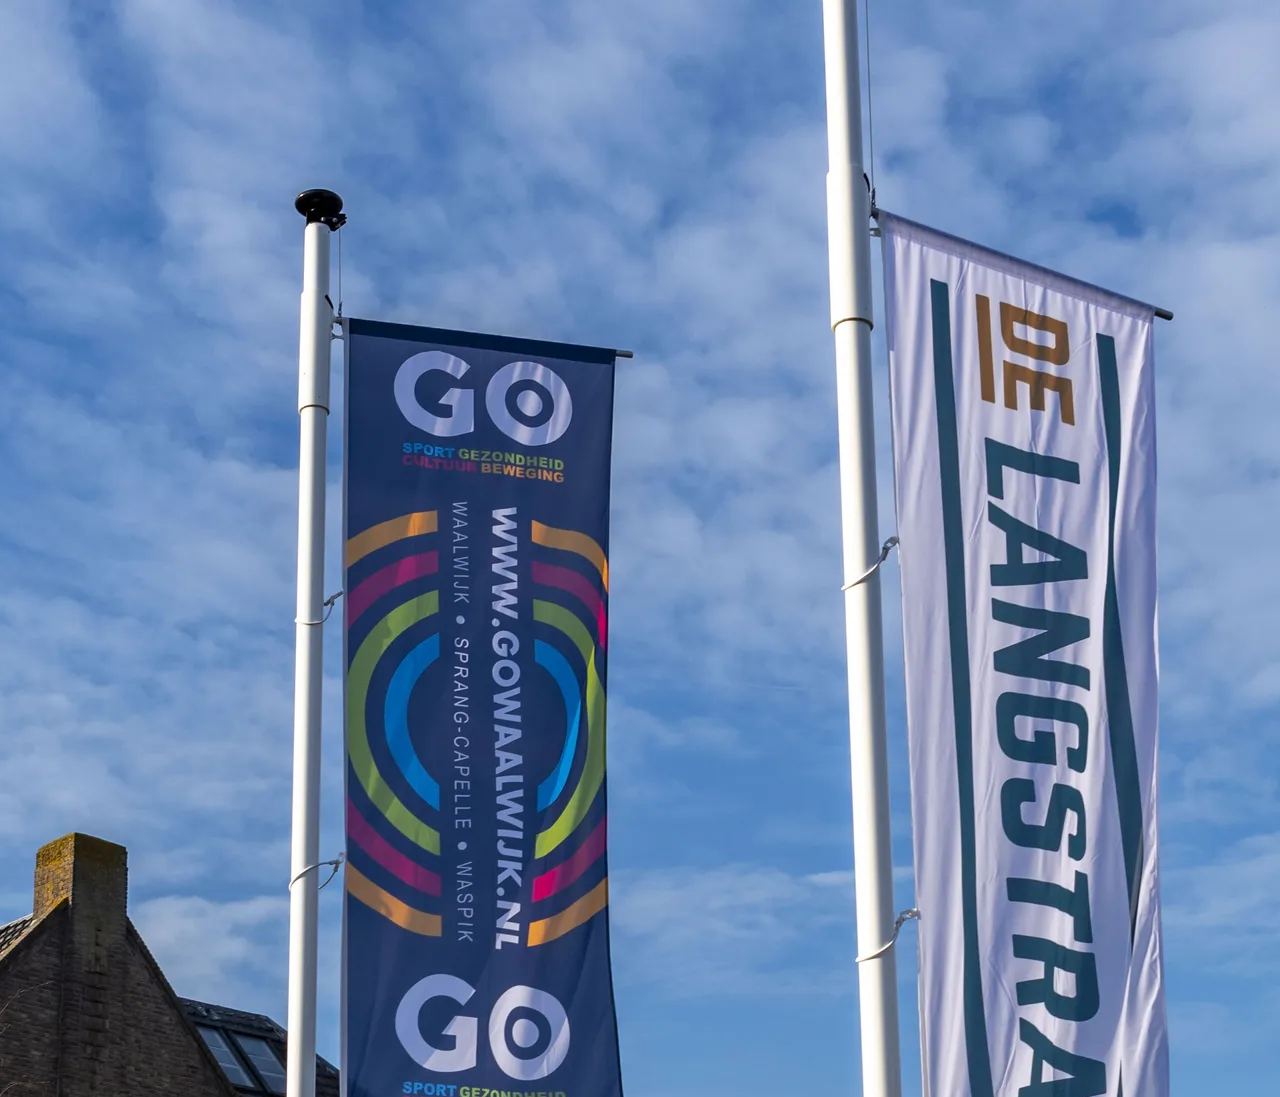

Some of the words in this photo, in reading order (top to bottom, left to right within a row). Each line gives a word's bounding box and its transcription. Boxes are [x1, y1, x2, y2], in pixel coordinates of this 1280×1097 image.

[393, 350, 573, 446] GO
[999, 301, 1075, 426] DE
[402, 455, 477, 474] CULTUUR
[481, 463, 565, 483] BEWEGING
[403, 442, 456, 458] SPORT
[458, 448, 565, 471] GEZONDHEID
[452, 501, 470, 605] WAALWIJK
[454, 637, 472, 829] SPRANG-CAPELLE
[492, 507, 524, 950] WWW.GOWAALWIJK.NL
[457, 862, 474, 943] WASPIK
[394, 973, 571, 1081] GO
[402, 1081, 457, 1097] SPORT
